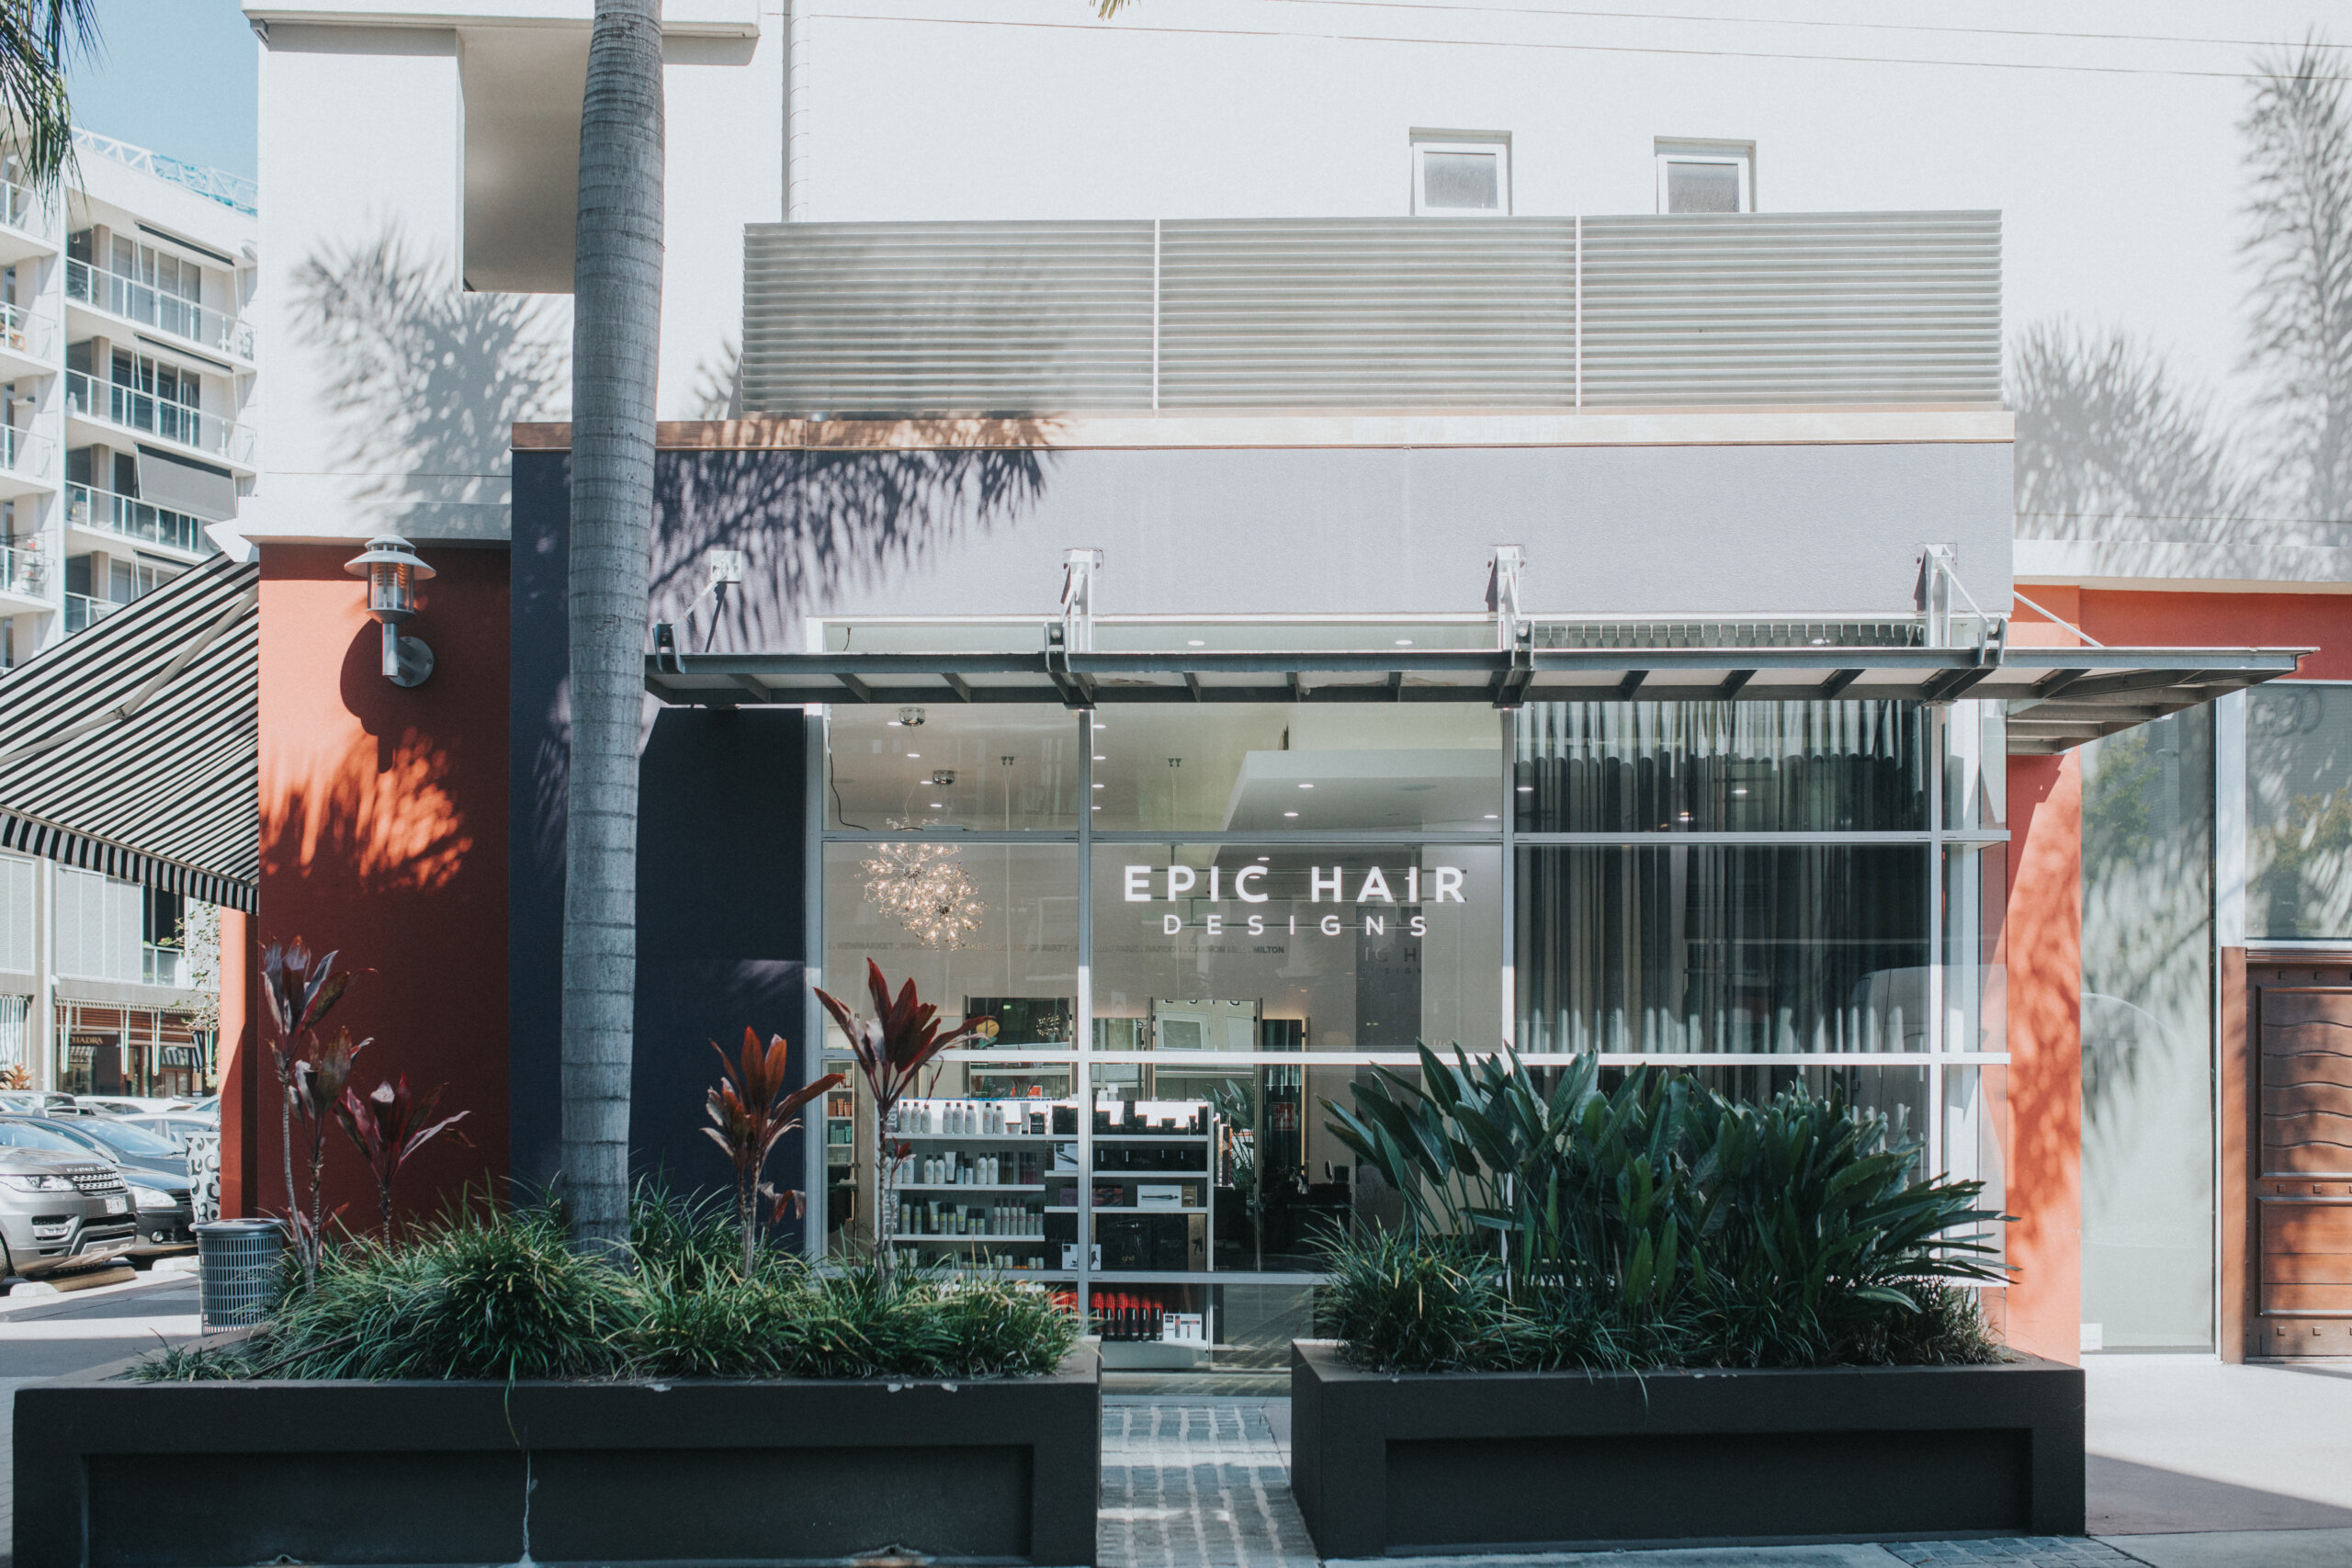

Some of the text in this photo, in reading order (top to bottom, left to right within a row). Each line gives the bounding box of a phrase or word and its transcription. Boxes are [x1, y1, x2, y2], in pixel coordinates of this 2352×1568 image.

[1125, 865, 1466, 903] EPIC HAIR
[1163, 915, 1427, 937] DESIGNS
[1252, 945, 1284, 953] MILTON
